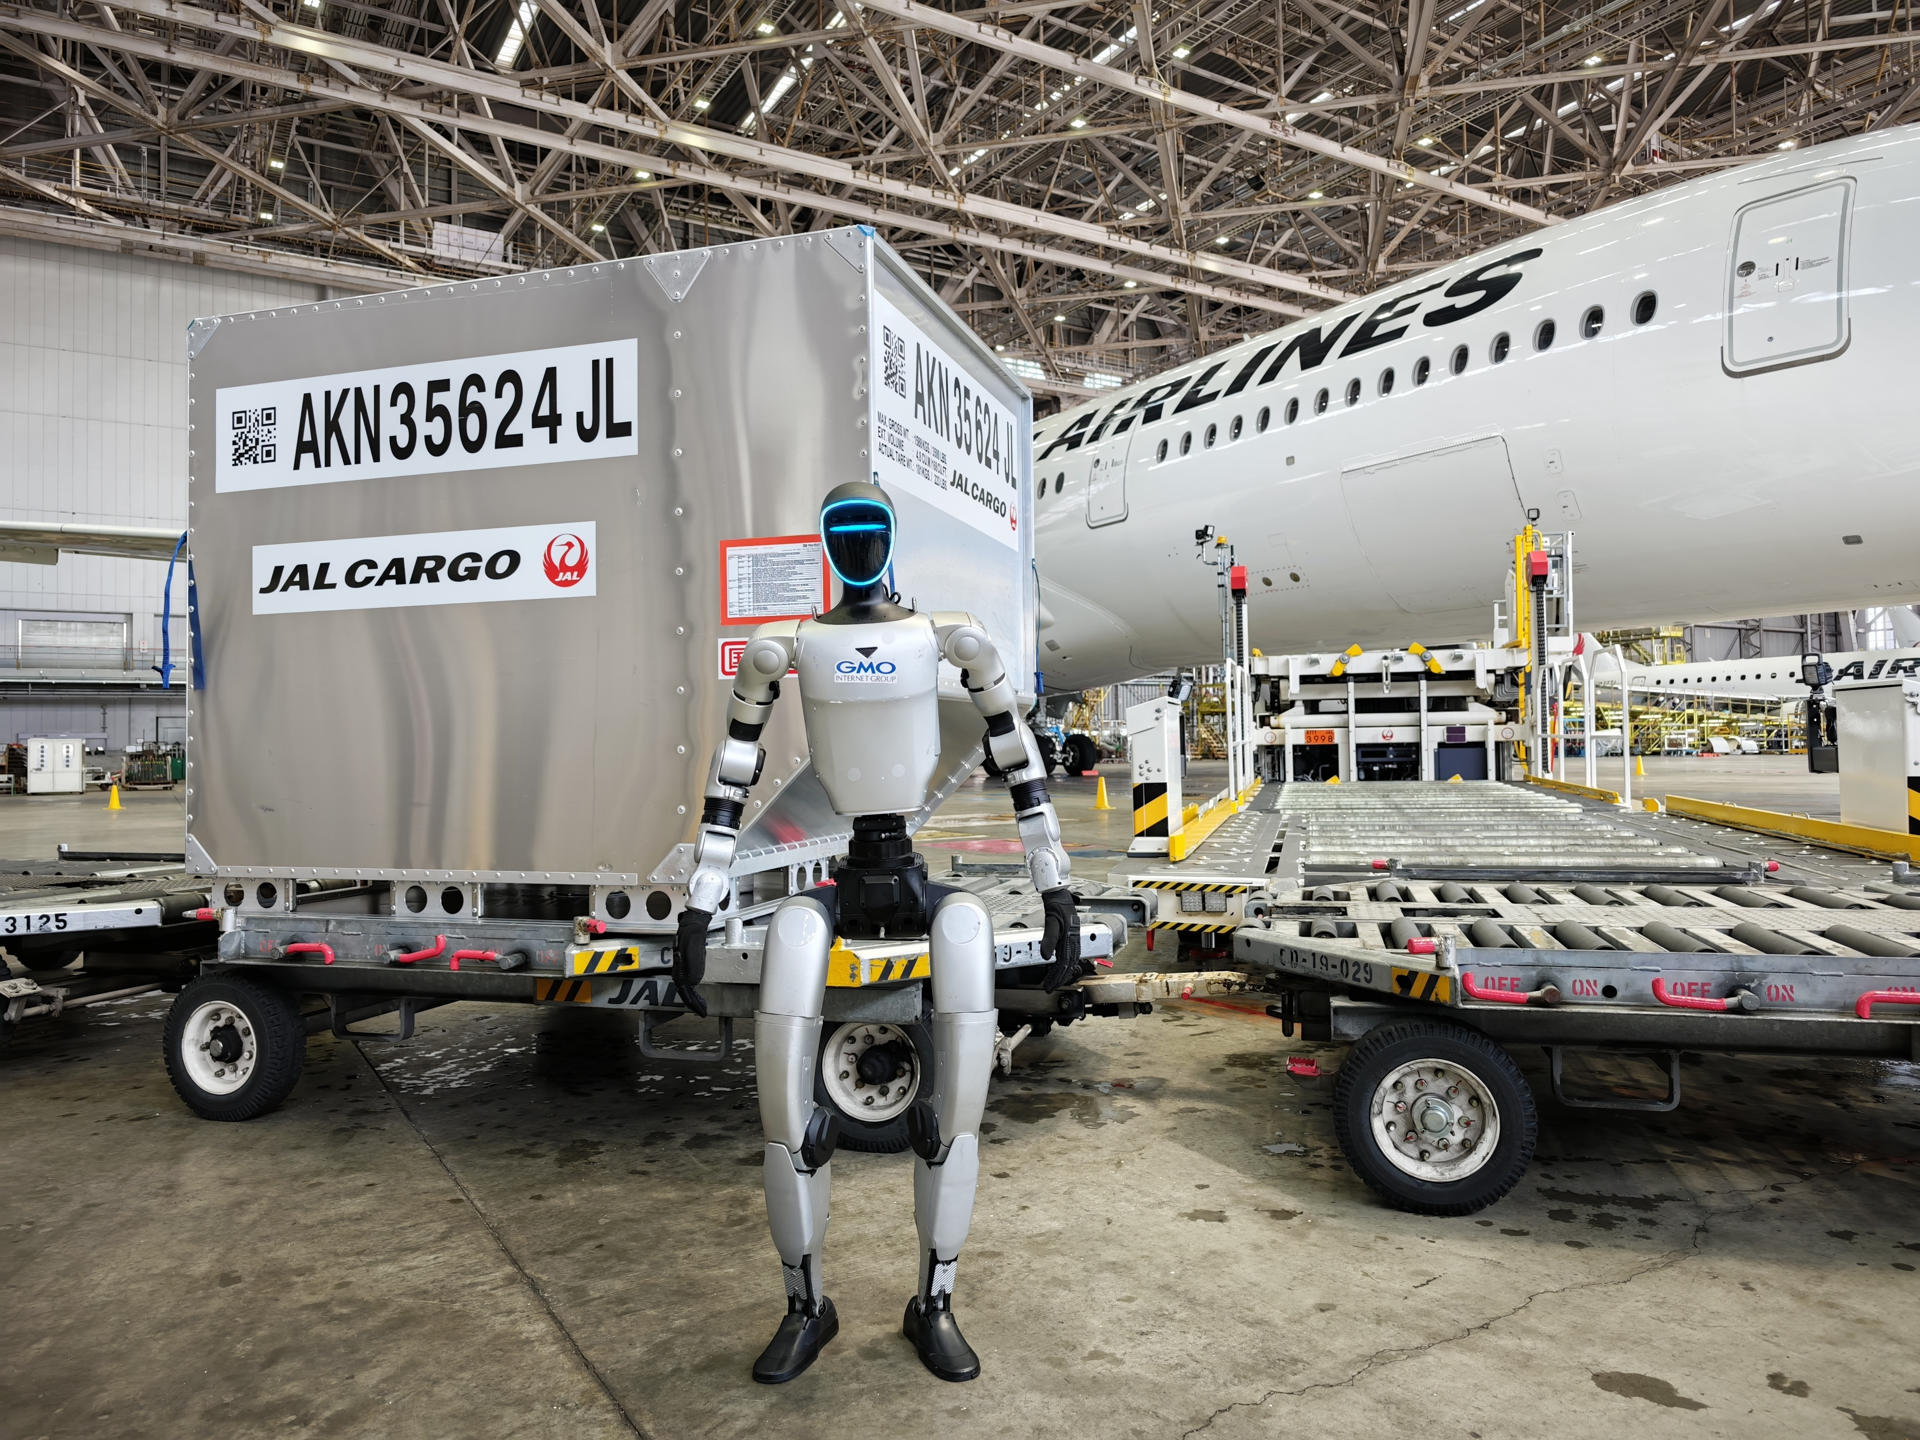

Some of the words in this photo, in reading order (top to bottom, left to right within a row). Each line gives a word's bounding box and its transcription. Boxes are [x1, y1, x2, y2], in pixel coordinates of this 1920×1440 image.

[1036, 248, 1543, 462] AIRLINES
[971, 474, 1007, 518] CARGO
[258, 562, 337, 594] JAL
[344, 549, 521, 589] CARGO
[554, 571, 581, 582] JAL
[836, 660, 897, 675] GMO
[836, 674, 870, 682] INTERNET
[870, 674, 897, 683] GROUP
[4, 912, 68, 934] 3125
[1279, 947, 1374, 985] CD-19-029
[1571, 978, 1598, 997] ON
[1766, 983, 1796, 1002] ON
